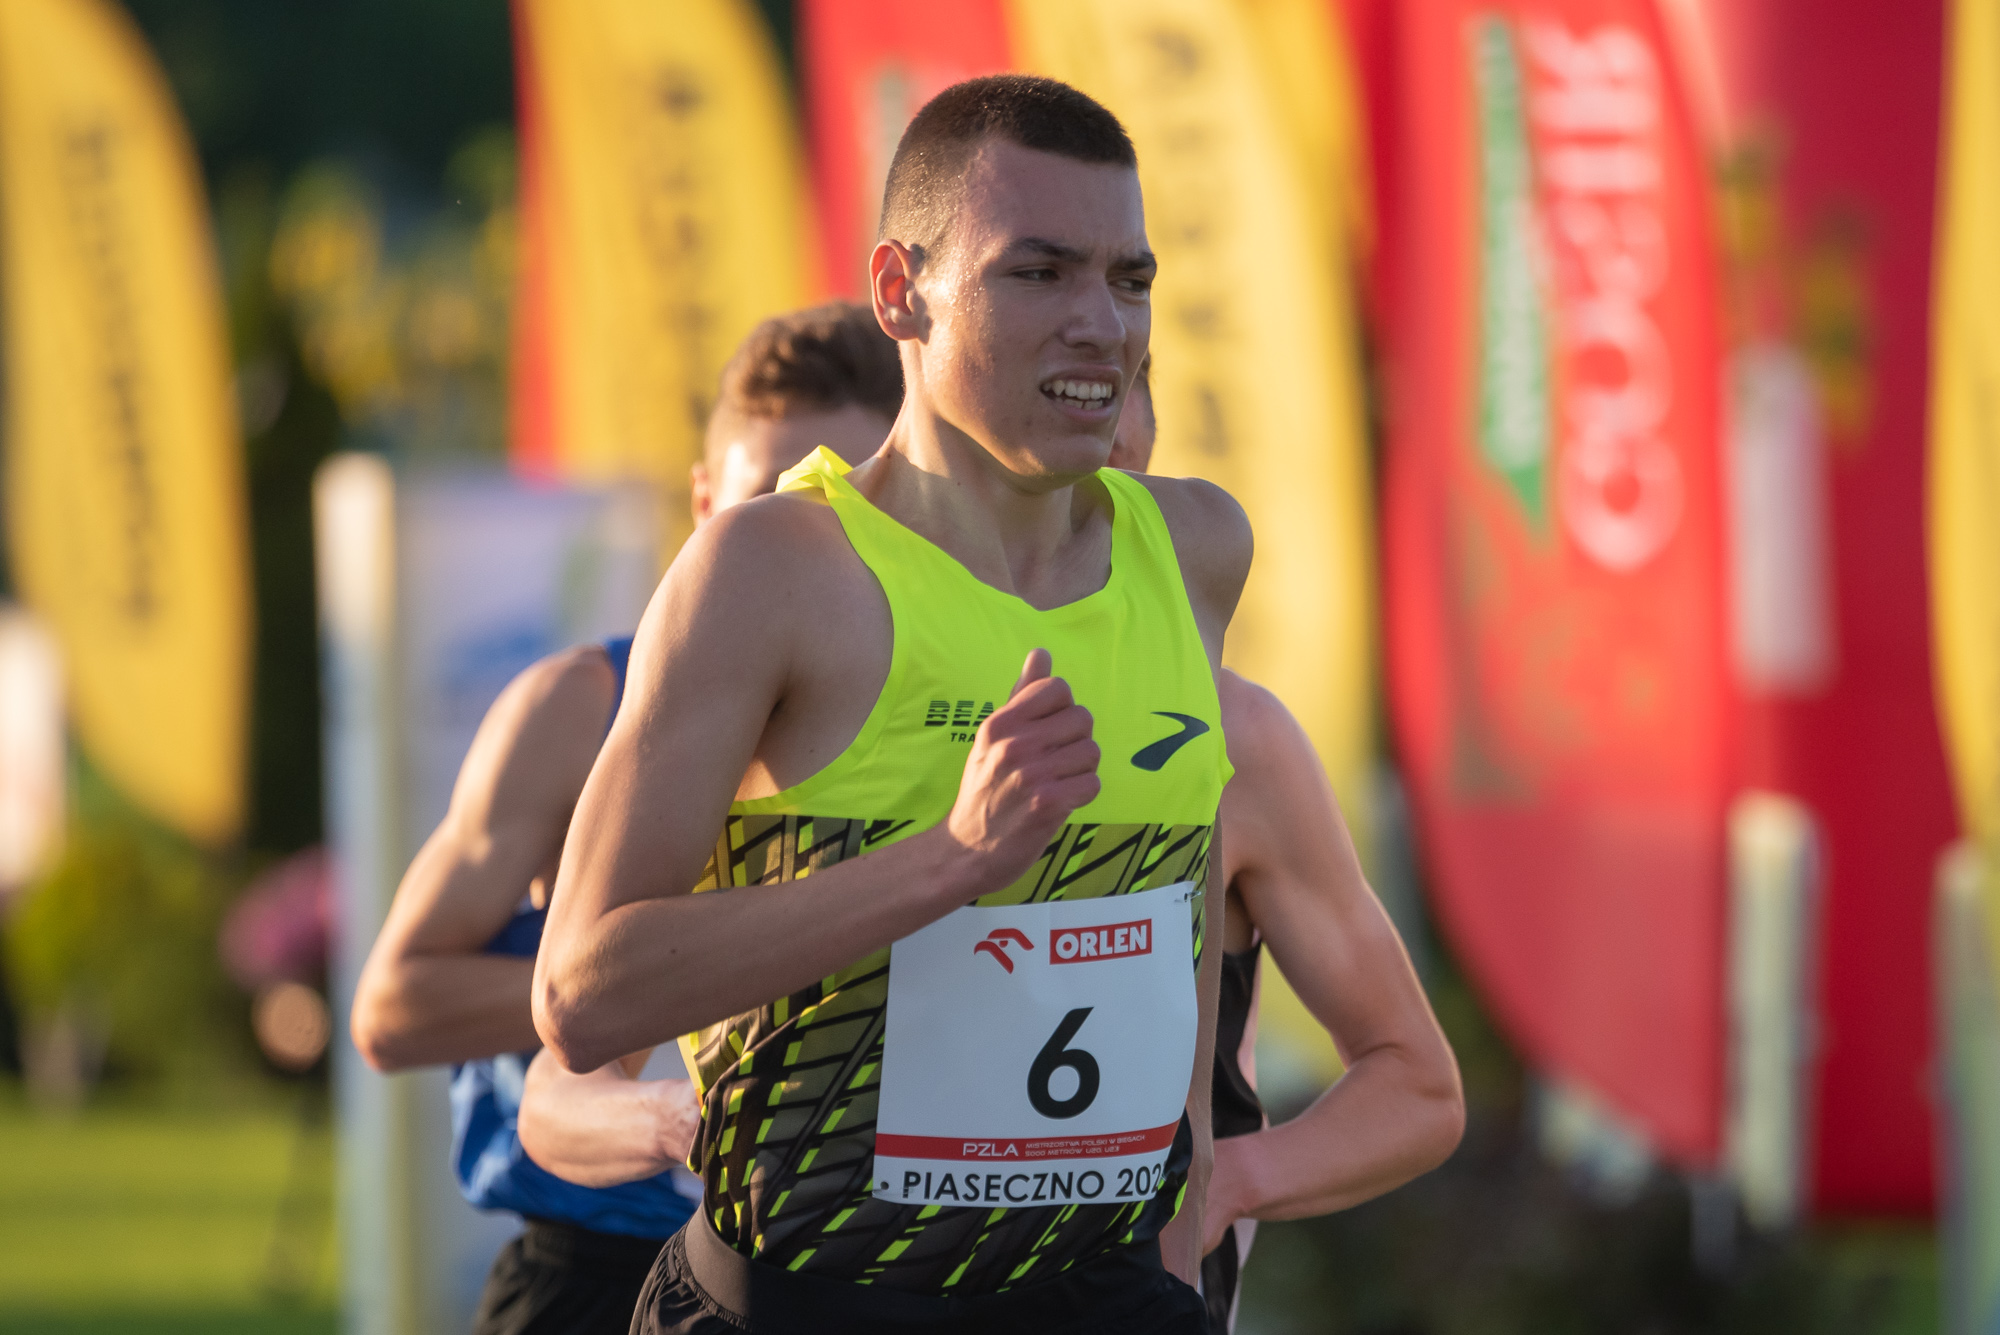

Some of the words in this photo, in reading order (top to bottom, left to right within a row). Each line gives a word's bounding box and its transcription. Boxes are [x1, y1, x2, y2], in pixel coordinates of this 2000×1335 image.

[924, 700, 995, 727] BEA
[950, 732, 976, 743] TRA
[1055, 924, 1149, 960] ORLEN
[1027, 1006, 1100, 1120] 6
[962, 1142, 1019, 1157] PZLA
[1025, 1141, 1080, 1149] MISTRZOSTWA
[1117, 1135, 1145, 1144] BIEGACH
[902, 1170, 1104, 1203] PIASECZNO
[1115, 1162, 1162, 1198] 202
